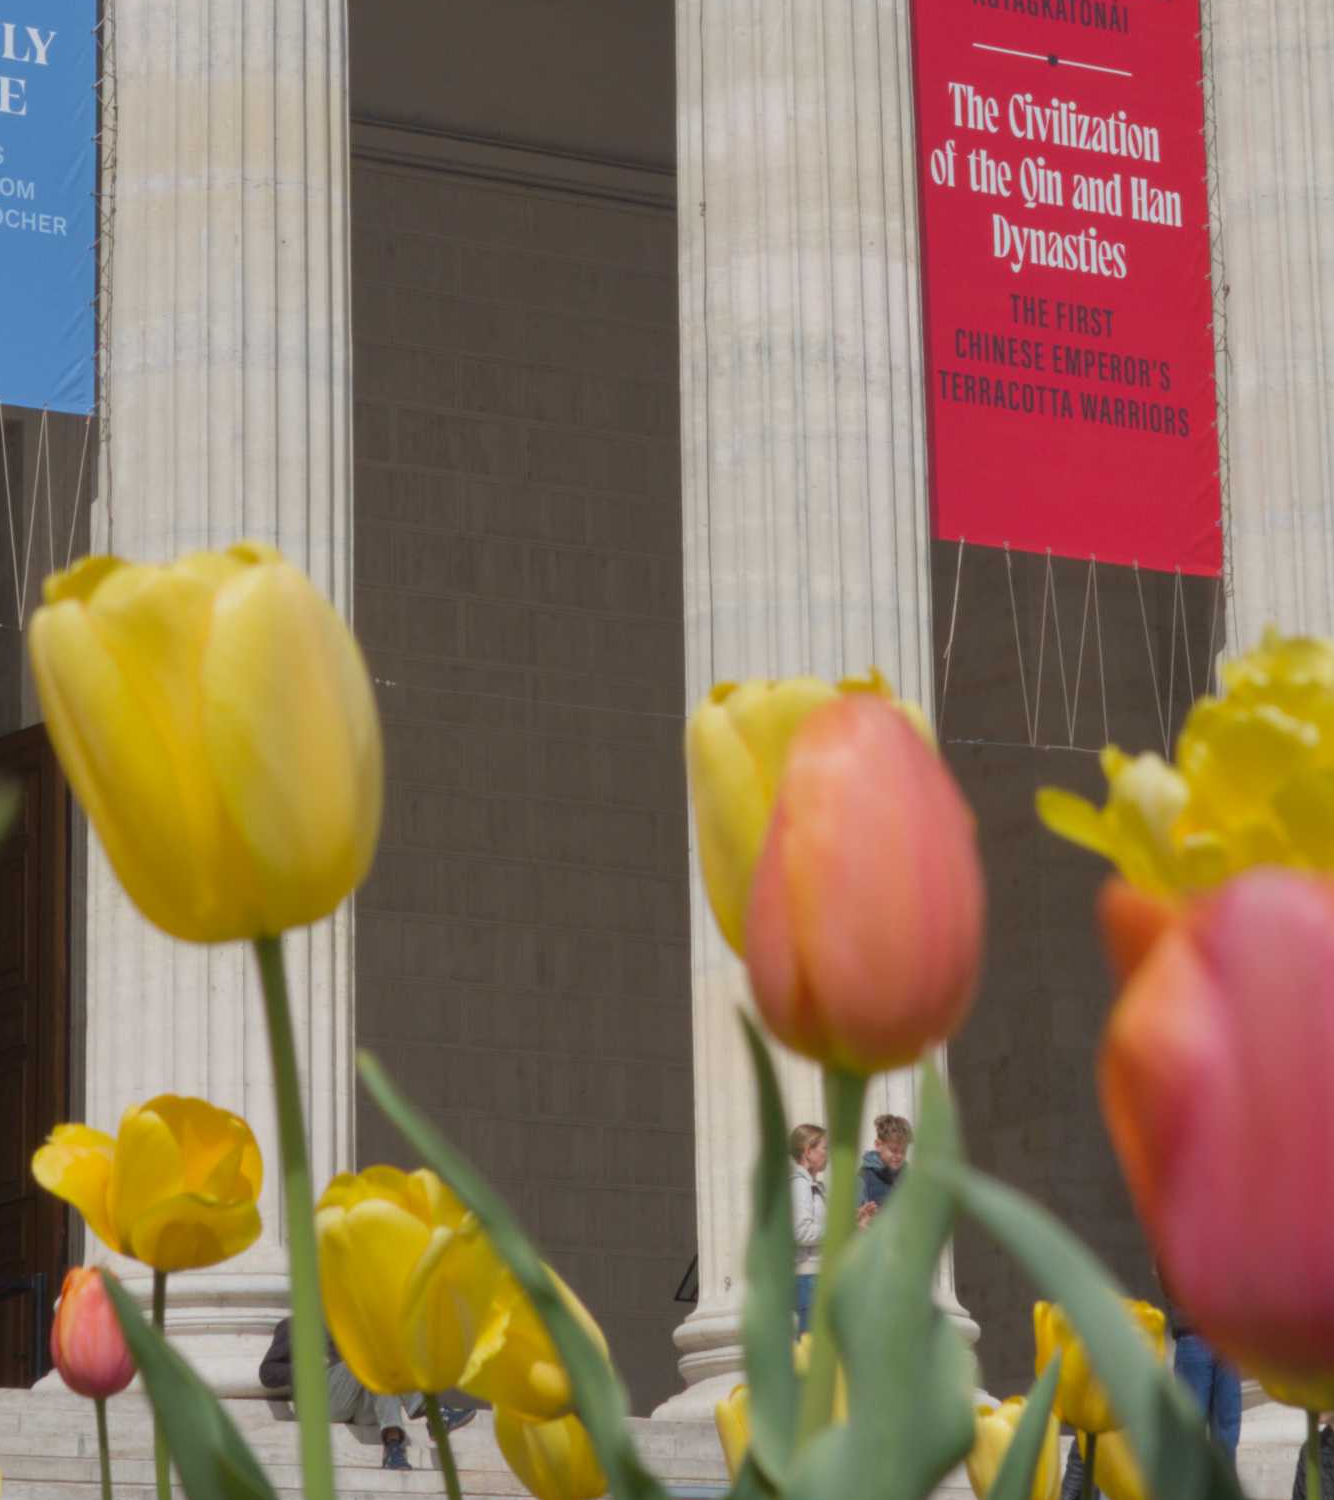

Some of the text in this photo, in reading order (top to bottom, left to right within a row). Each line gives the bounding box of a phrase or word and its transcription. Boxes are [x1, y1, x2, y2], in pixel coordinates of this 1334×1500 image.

[948, 81, 1161, 163] The Civilization
[930, 139, 1183, 228] of the Qin and Han
[992, 213, 1127, 280] Dynasties
[1010, 294, 1114, 339] THE FIRST
[955, 328, 1171, 392] CHINESE EMPEROR'S
[938, 369, 1190, 438] TERRACOTTA WARRIORS
